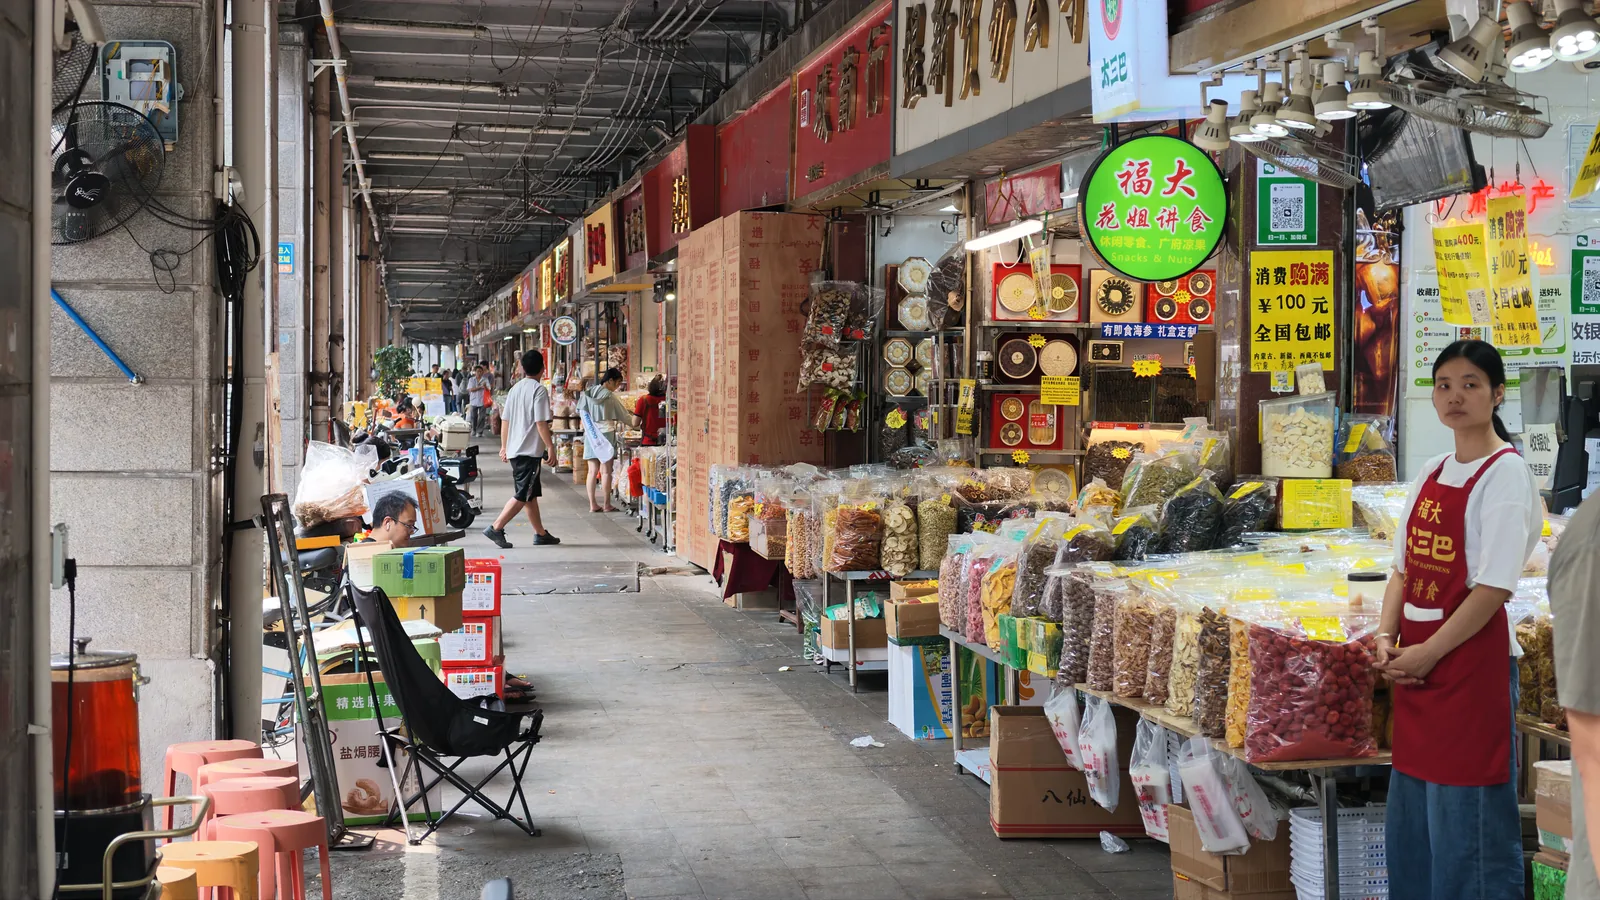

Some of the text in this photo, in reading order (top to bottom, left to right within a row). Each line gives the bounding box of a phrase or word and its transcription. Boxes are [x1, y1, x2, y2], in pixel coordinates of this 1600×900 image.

[1116, 159, 1197, 198] 福大
[1094, 202, 1213, 234] 花姐讲食
[1099, 235, 1207, 251] 休闲零食、广府凉果
[1111, 252, 1194, 265] Snacks & Nuts
[1255, 261, 1330, 287] 消费购满
[1103, 324, 1197, 338] 有即食海参 礼盒定制
[1254, 322, 1331, 343] 全国包邮
[1253, 351, 1332, 361] 内蒙古、新疆、西藏不包邮
[1417, 496, 1443, 524] 福大
